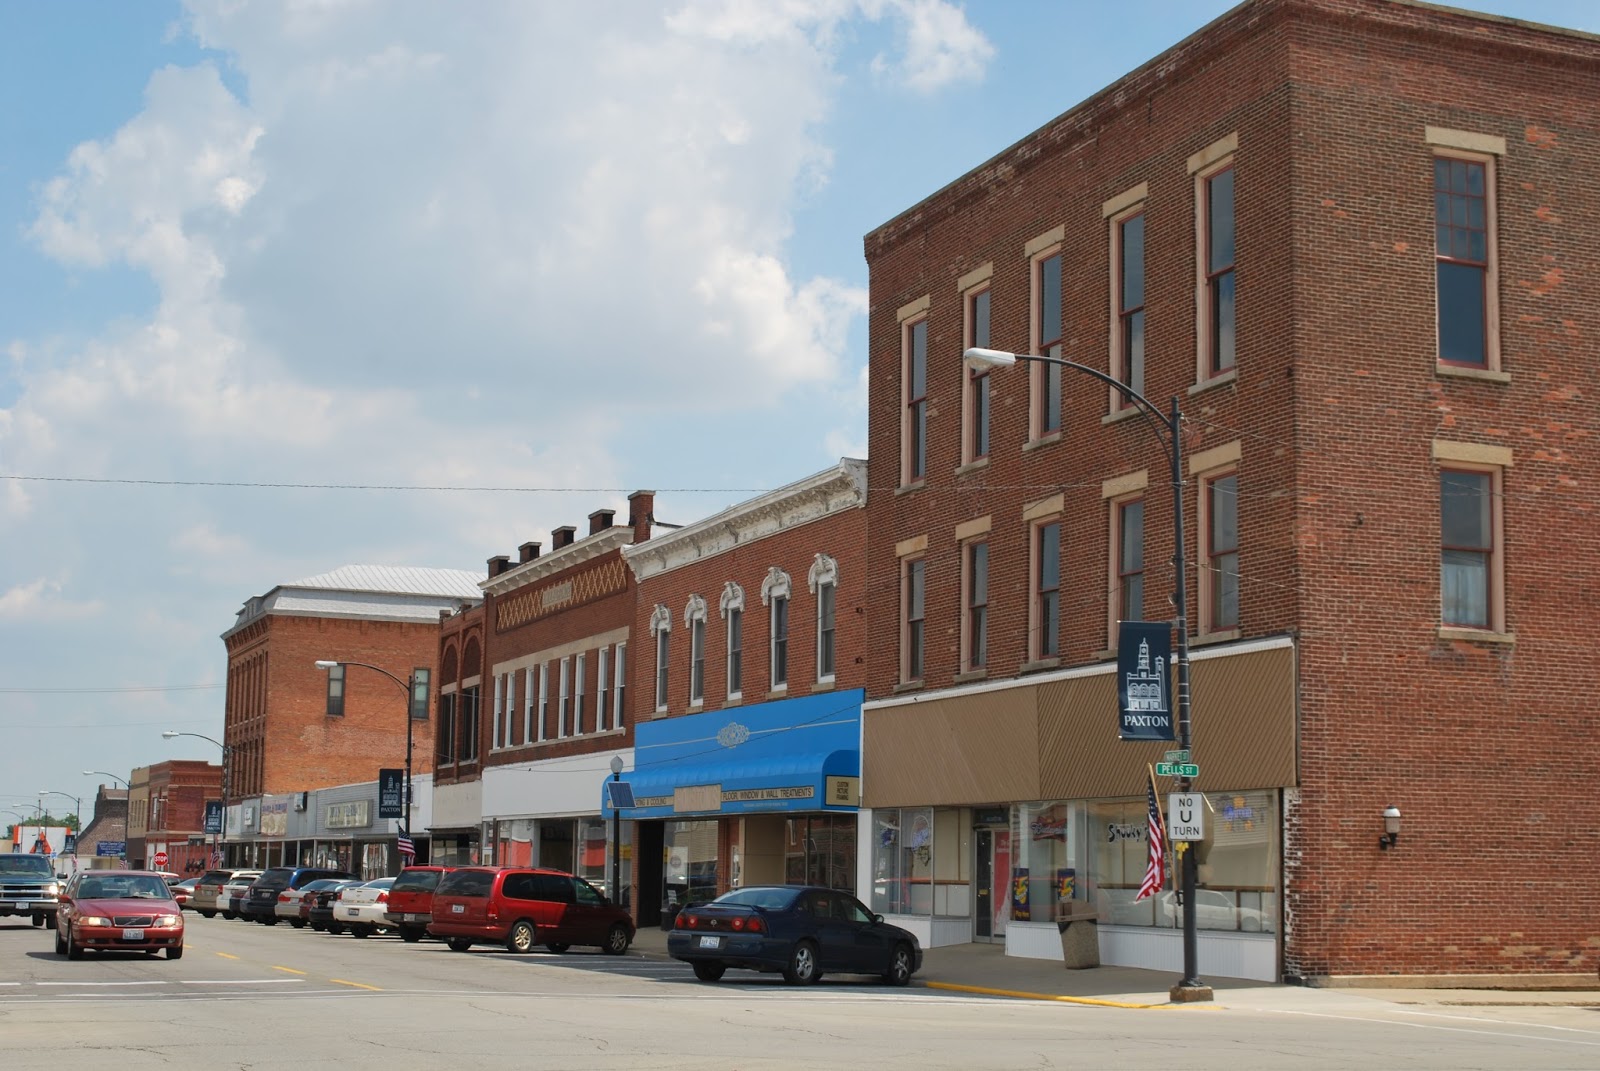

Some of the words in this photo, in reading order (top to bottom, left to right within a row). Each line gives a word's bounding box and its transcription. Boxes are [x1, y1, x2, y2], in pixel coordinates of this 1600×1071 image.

[1124, 715, 1169, 727] PAXTON
[1161, 764, 1184, 775] PELLS
[1185, 767, 1193, 775] ST
[740, 791, 759, 800] WINDOW
[760, 791, 765, 799] &
[765, 790, 779, 798] WALL
[780, 787, 812, 798] TREATMENTS
[650, 797, 667, 807] COOLING
[1178, 798, 1193, 808] NO
[1180, 811, 1192, 823] U
[1173, 826, 1200, 836] TURN
